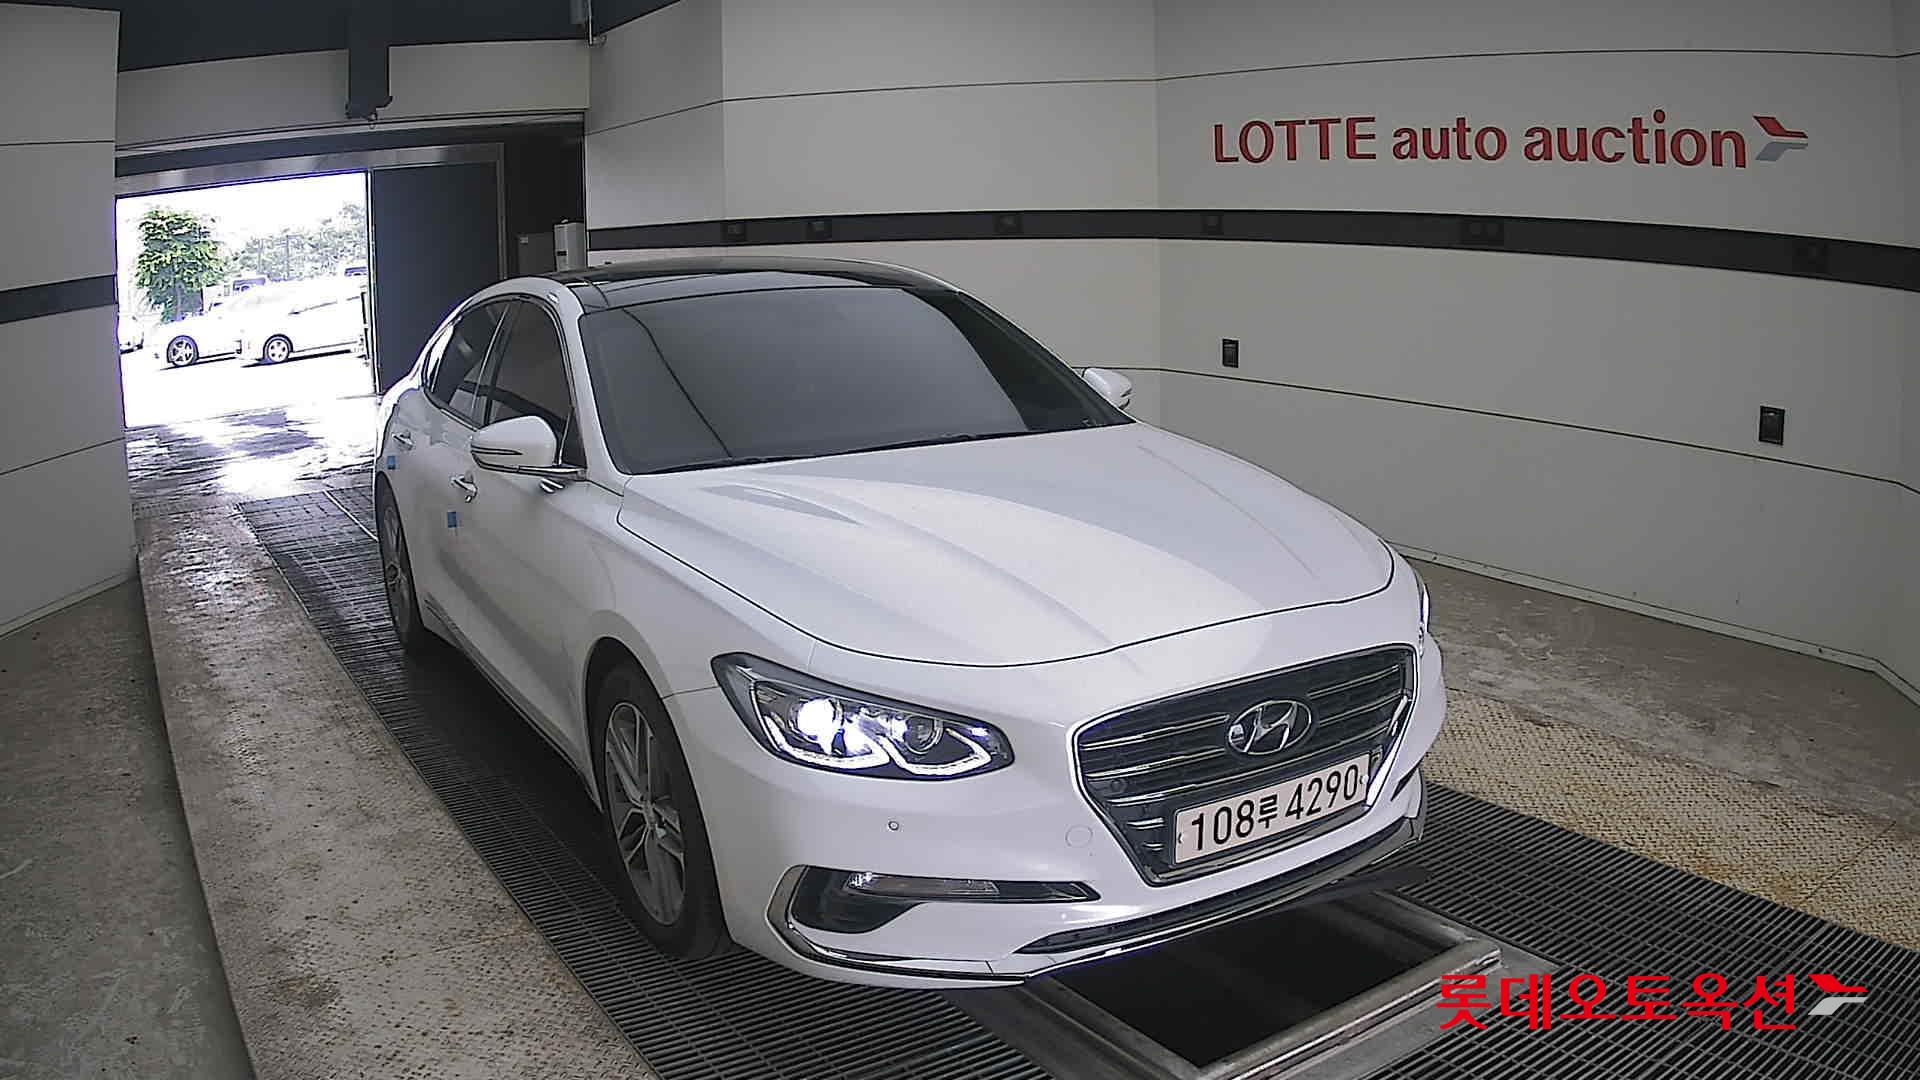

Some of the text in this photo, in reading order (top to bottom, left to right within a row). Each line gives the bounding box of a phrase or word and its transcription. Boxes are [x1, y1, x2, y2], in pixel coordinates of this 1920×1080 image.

[1213, 108, 1747, 169] LOTTE auto auction
[1284, 764, 1359, 820] 4290
